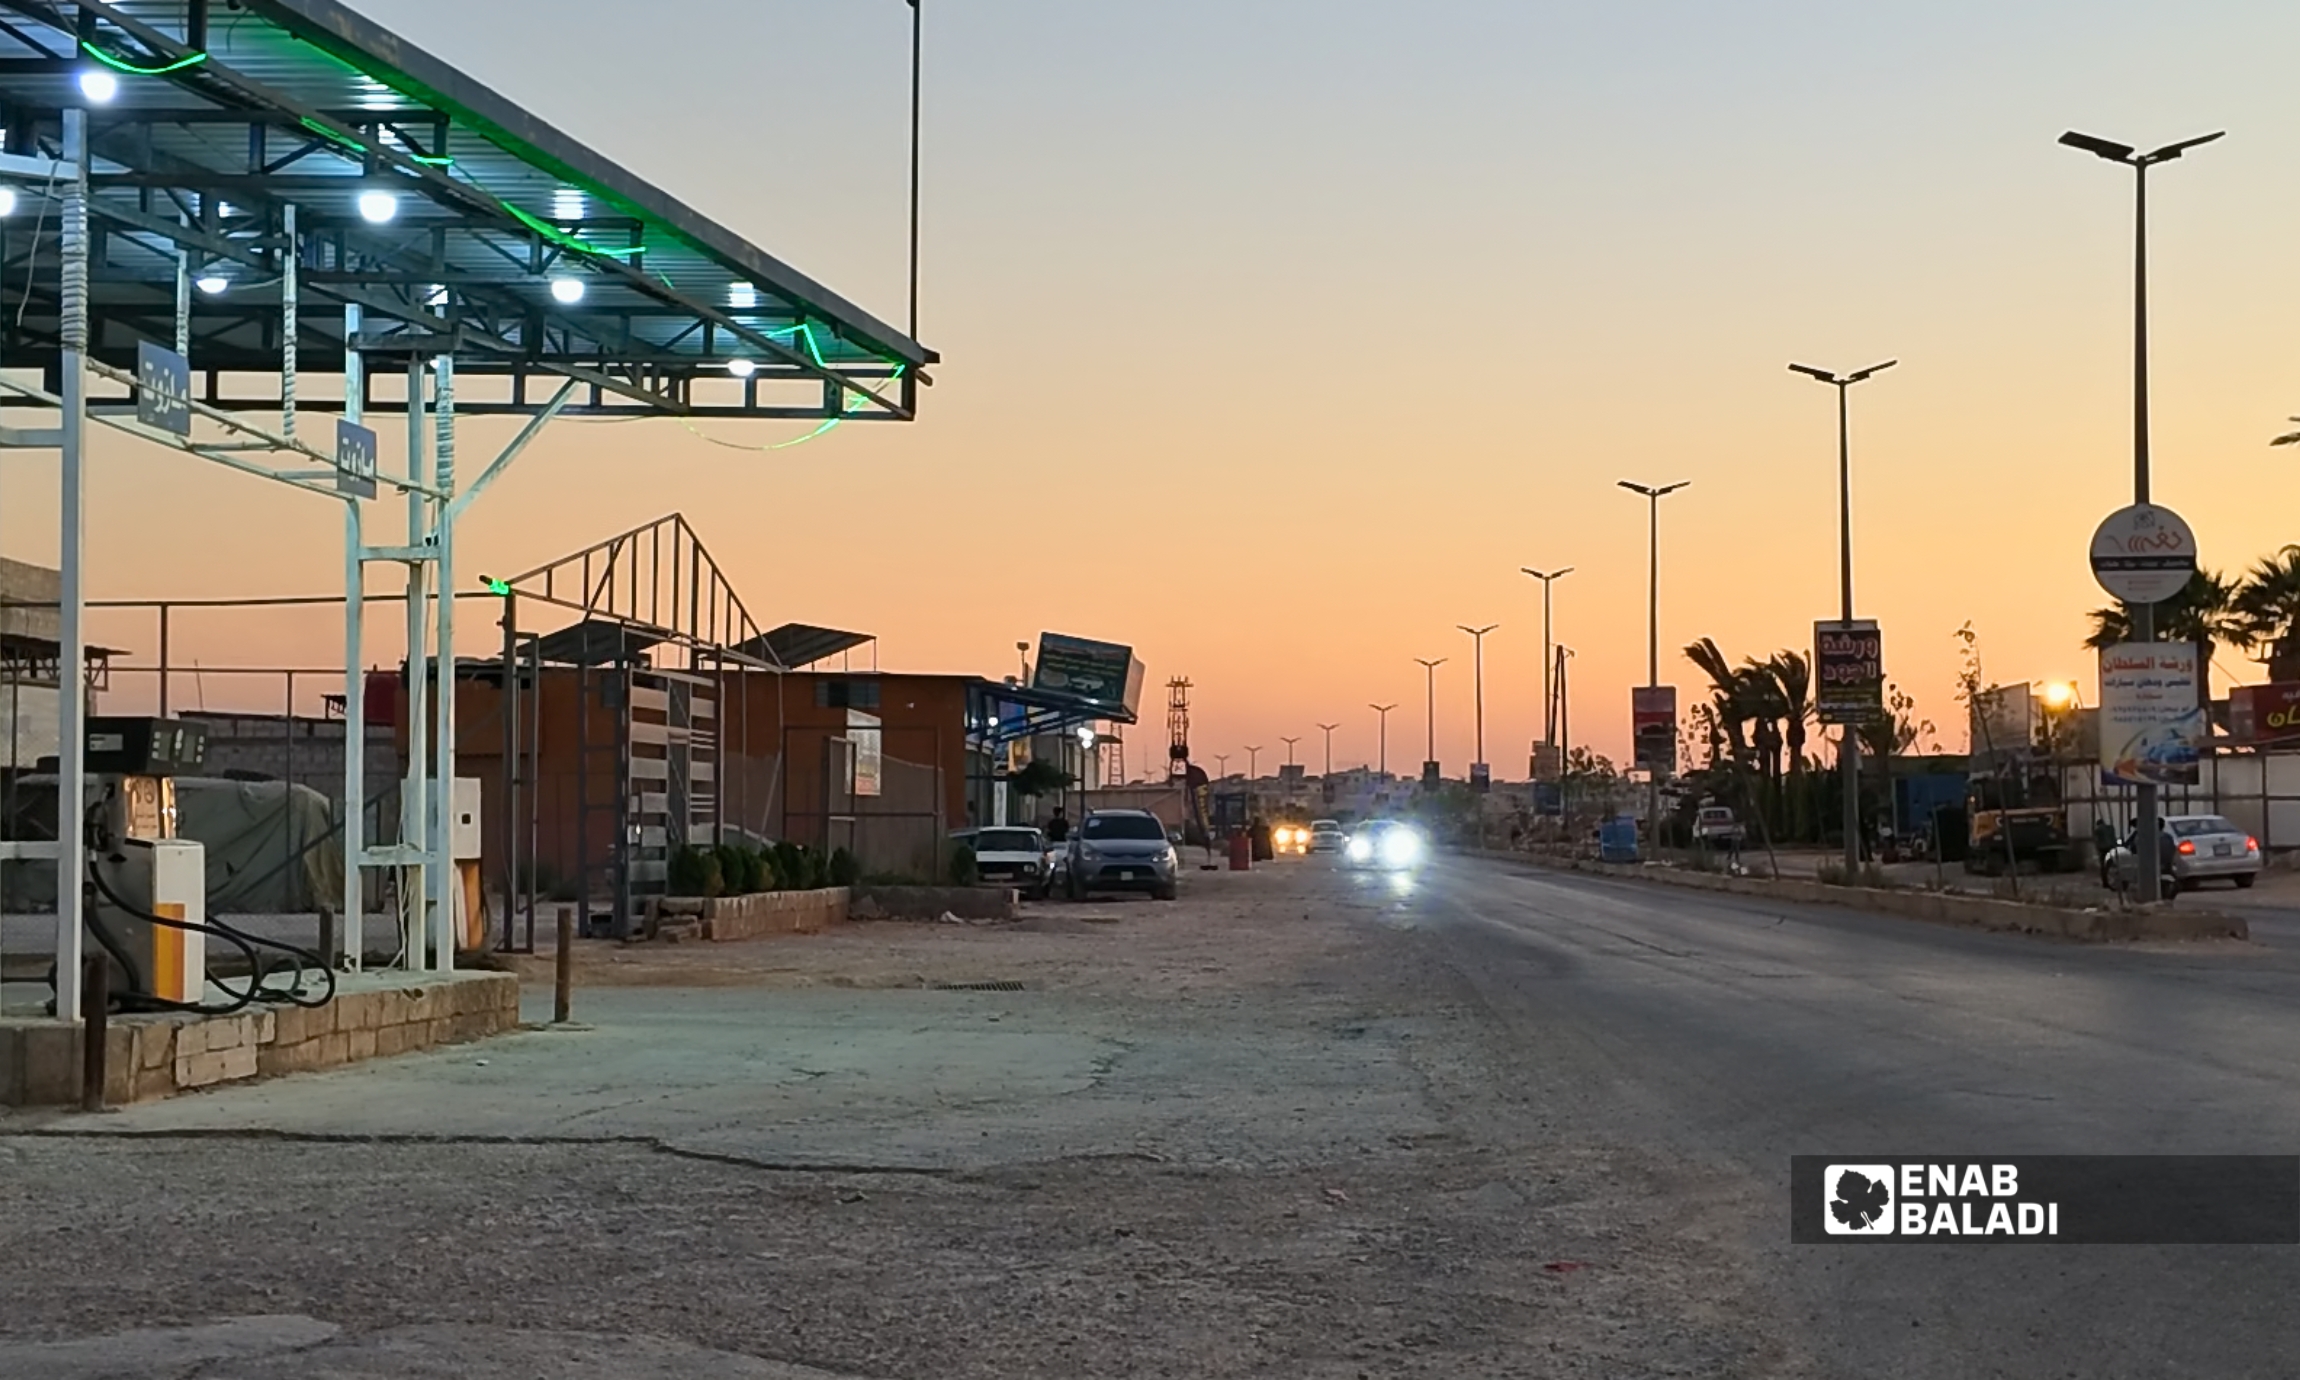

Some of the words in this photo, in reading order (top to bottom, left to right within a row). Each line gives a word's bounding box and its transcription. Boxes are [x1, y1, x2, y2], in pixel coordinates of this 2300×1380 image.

[143, 361, 187, 414] مازوت
[1820, 634, 1879, 658] ورشة
[2103, 656, 2155, 673] السلطان
